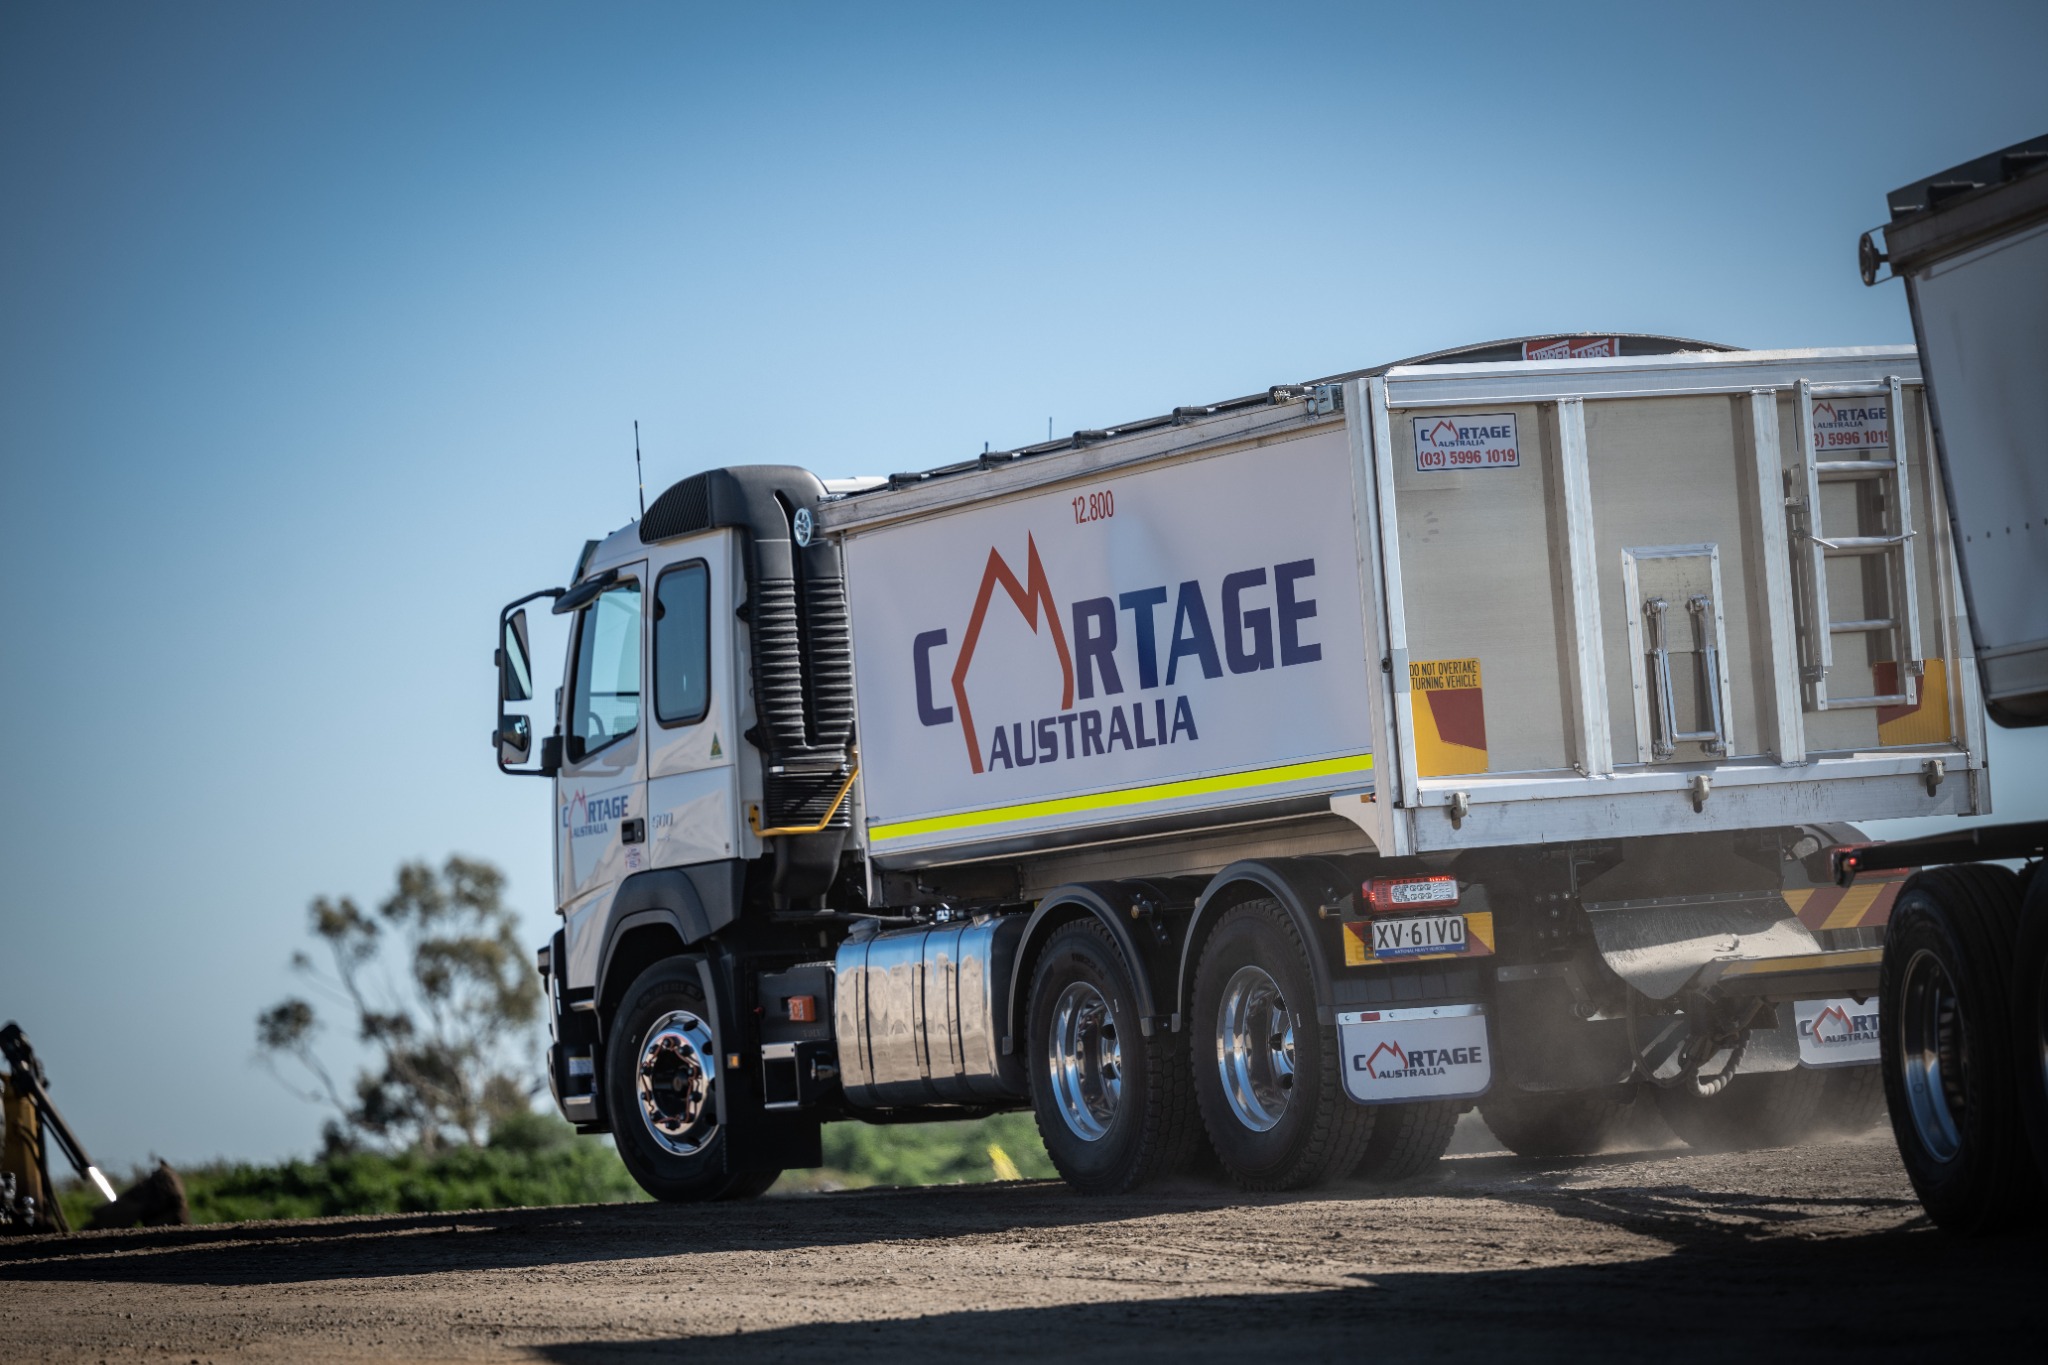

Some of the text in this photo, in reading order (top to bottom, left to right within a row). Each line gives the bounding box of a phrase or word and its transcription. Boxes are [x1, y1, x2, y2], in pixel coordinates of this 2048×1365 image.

[1438, 439, 1485, 447] AUSTRALIA
[1828, 432, 1860, 446] 5996
[1420, 448, 1515, 467] (03) 5996 1019
[1072, 490, 1114, 524] 12.800
[1409, 661, 1477, 676] DO NOT OVERTAKE
[1410, 674, 1477, 690] TURNING VEHICLE
[988, 695, 1199, 772] AUSTRALIA
[573, 823, 608, 837] AUSTRALIA
[1800, 1005, 1880, 1043] CART
[1824, 1032, 1880, 1043] AUSTRAL
[1378, 1067, 1446, 1079] AUSTRALIA
